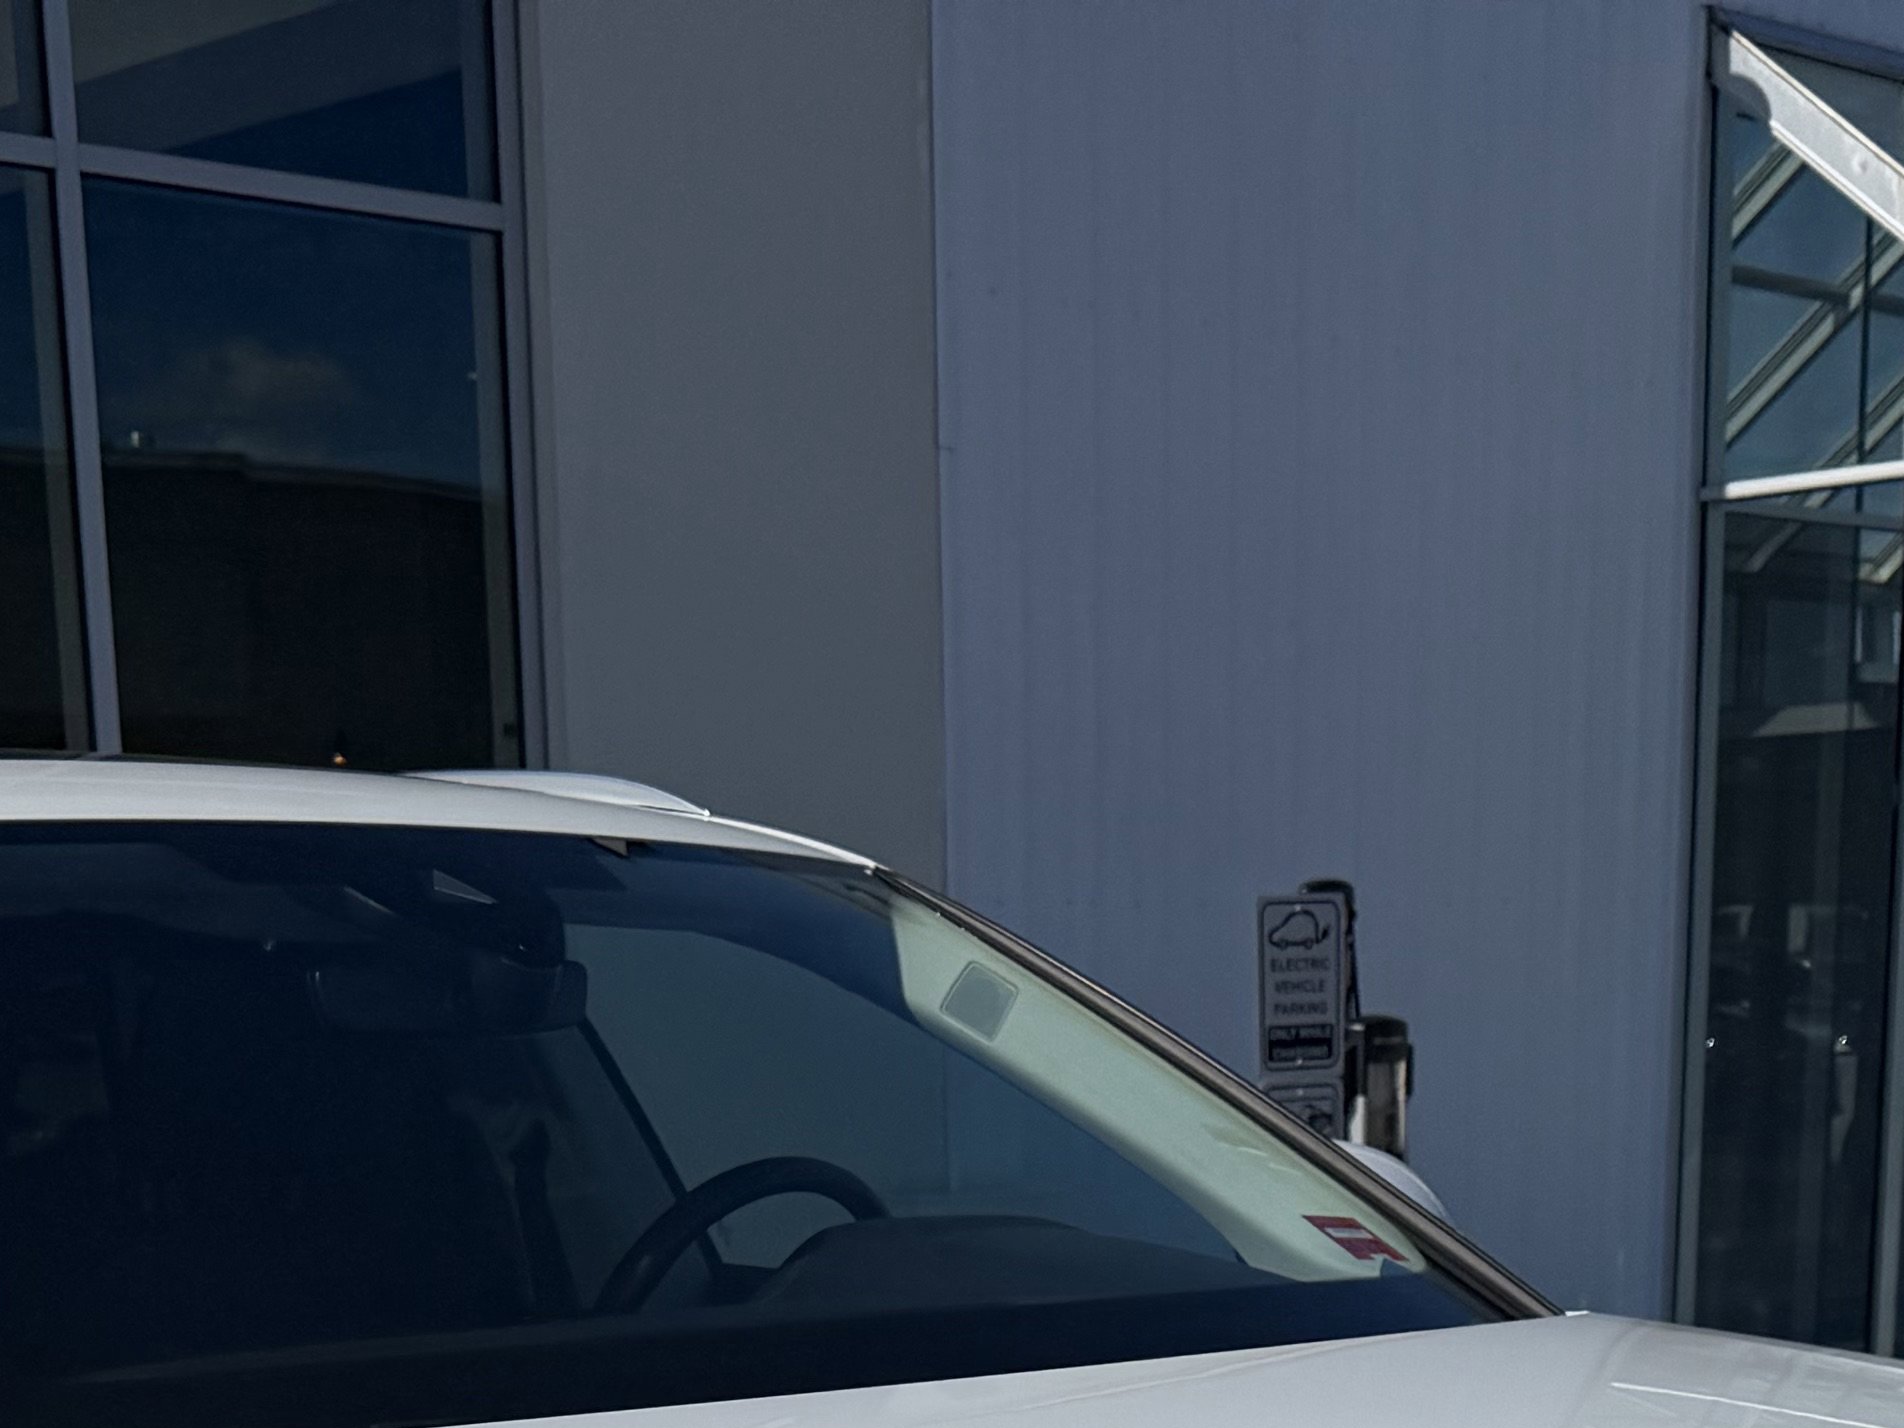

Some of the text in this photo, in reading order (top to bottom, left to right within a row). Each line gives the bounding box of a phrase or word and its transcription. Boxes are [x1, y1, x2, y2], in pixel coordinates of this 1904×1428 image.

[1270, 957, 1330, 973] ELECTRIC
[1275, 979, 1325, 995] VEHICLE
[1273, 1001, 1327, 1016] PARKING
